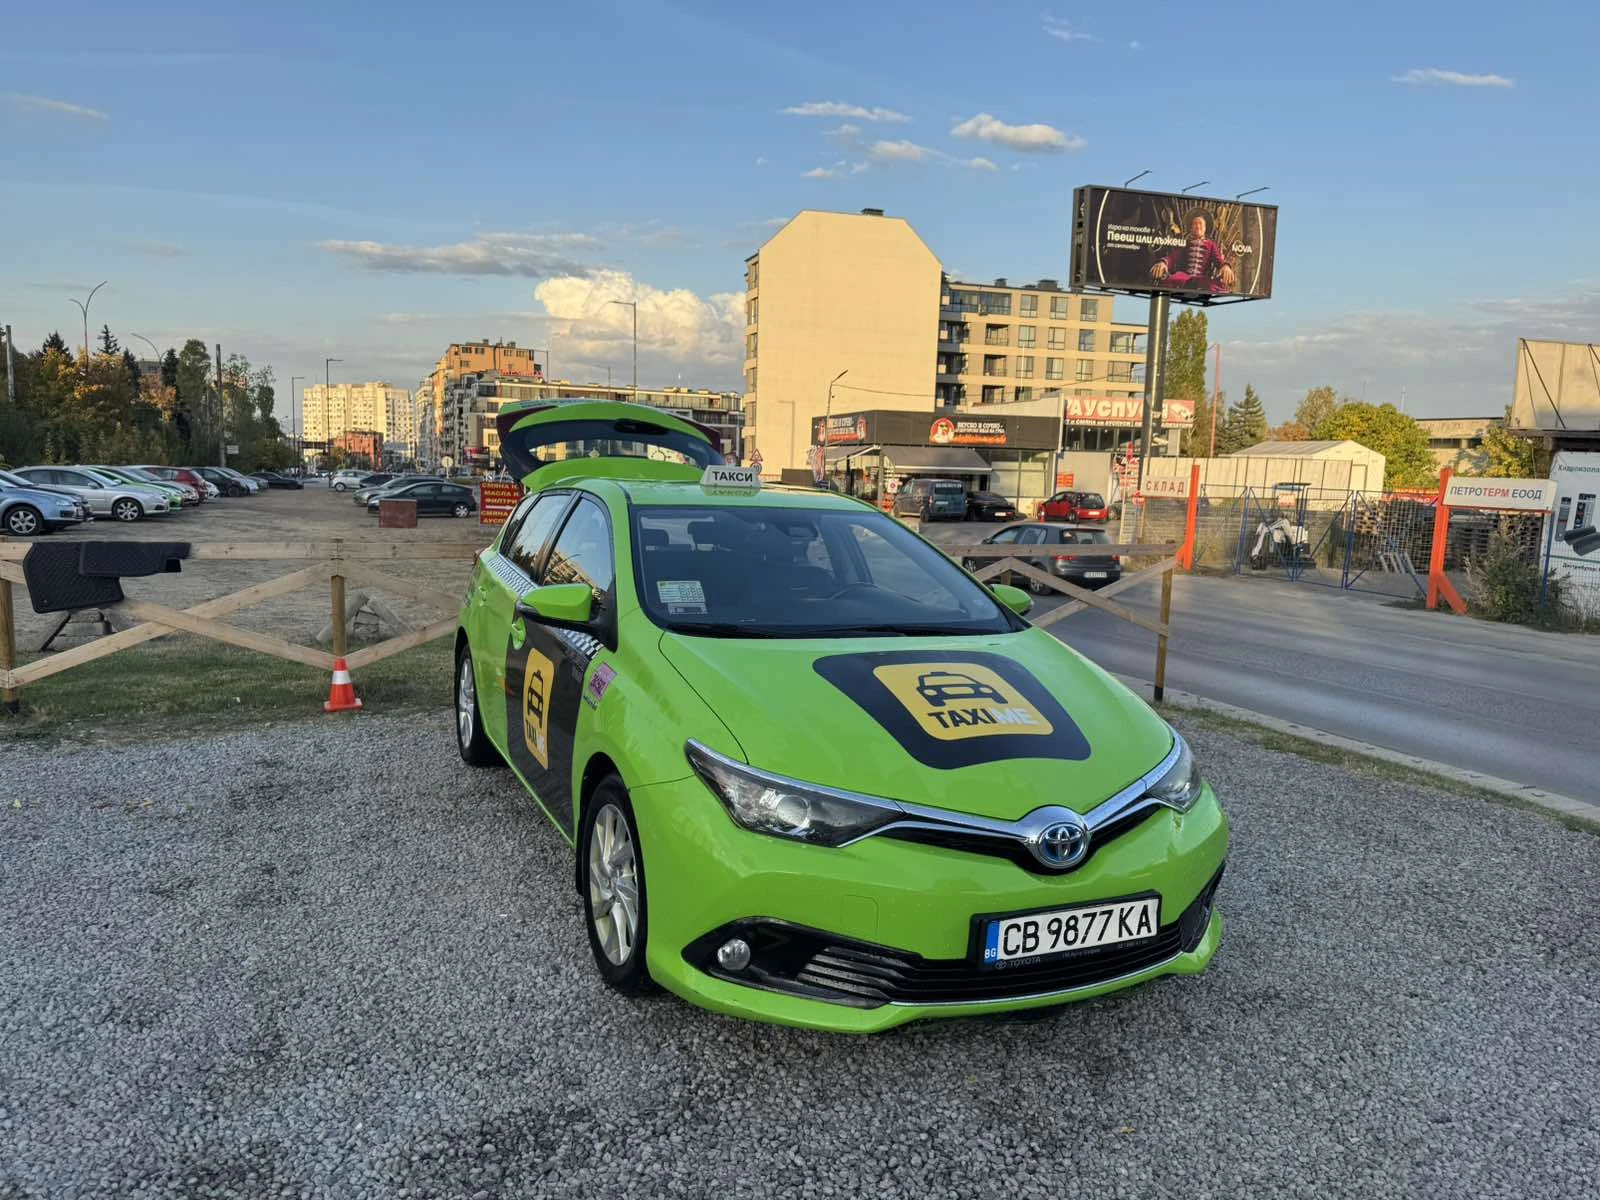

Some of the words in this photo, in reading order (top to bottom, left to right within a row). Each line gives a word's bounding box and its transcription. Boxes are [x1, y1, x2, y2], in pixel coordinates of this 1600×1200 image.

[1107, 231, 1135, 242] Пееш
[1135, 235, 1152, 244] или
[1231, 244, 1253, 254] NOVA
[1069, 399, 1168, 418] АУСПУ
[712, 471, 753, 482] ТАКСИ
[1146, 480, 1185, 496] СКЛАД
[1450, 486, 1510, 497] ПЕТРОТЕРМ
[1511, 488, 1542, 500] ЕООД
[984, 948, 997, 960] BG
[1009, 956, 1041, 968] TOYOTA
